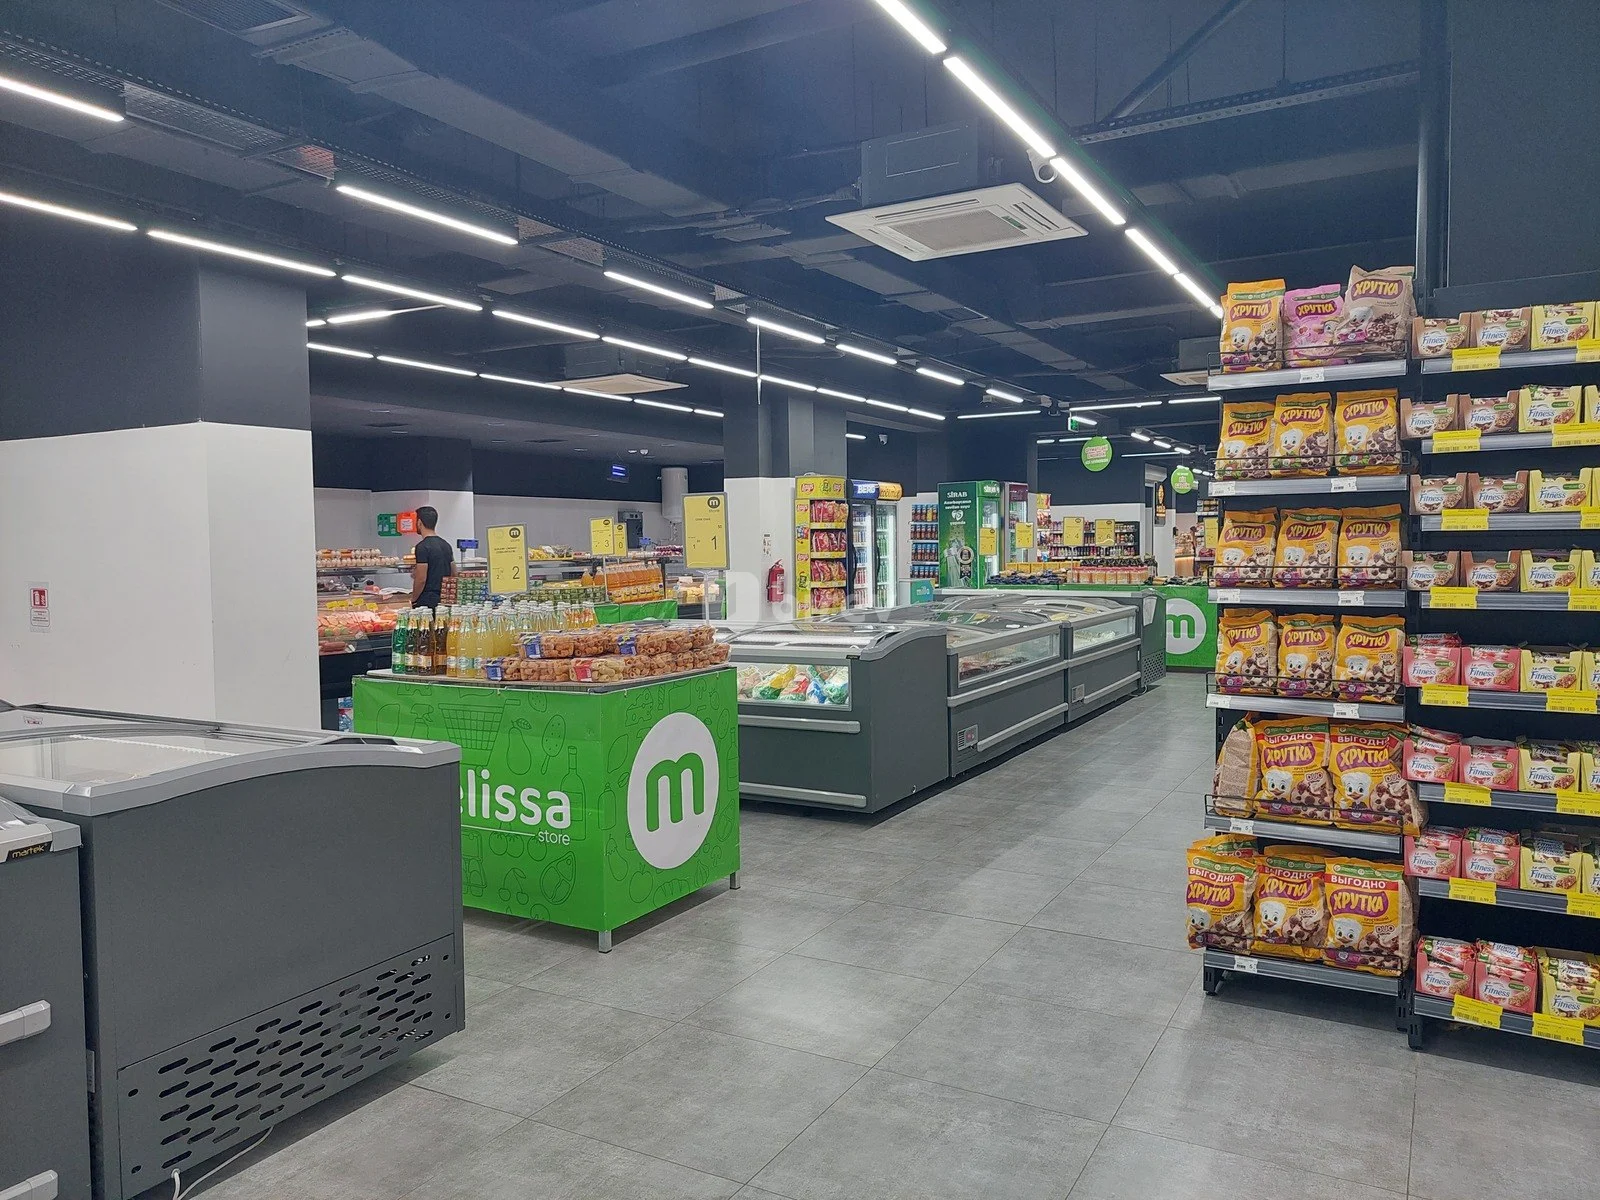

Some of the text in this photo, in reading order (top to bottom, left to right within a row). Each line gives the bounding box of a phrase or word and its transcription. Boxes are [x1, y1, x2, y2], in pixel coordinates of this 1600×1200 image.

[1354, 280, 1399, 296] ХРУТКА
[1232, 303, 1270, 317] ХРУТКА
[1298, 302, 1335, 315] ХРУТКА
[1481, 330, 1507, 340] Fitness
[1542, 325, 1569, 335] Fitness
[1422, 336, 1447, 345] Fitness
[1346, 399, 1385, 416] ХРУТКА
[1528, 408, 1555, 418] Fitness
[1281, 408, 1321, 421] ХРУТКА
[1470, 413, 1495, 422] Fitness
[1410, 417, 1435, 426] Fitness
[1230, 421, 1264, 436] ХРУТКА
[1419, 493, 1443, 503] Fitness
[1479, 492, 1504, 502] Fitness
[1539, 490, 1566, 500] Fitness
[1226, 526, 1263, 539] ХРУТКА
[1289, 524, 1325, 536] ХРУТКА
[1349, 523, 1387, 536] ХРУТКА
[604, 539, 610, 548] 3
[711, 534, 718, 551] 1
[512, 565, 521, 580] 2
[1410, 571, 1434, 581] Fitness
[1471, 570, 1497, 581] Fitness
[1529, 570, 1556, 580] Fitness
[1287, 630, 1324, 642] ХРУТКА
[1349, 634, 1387, 646] ХРУТКА
[1412, 665, 1437, 676] Fitness
[1469, 667, 1495, 678] Fitness
[1530, 671, 1557, 681] Fitness
[1267, 746, 1311, 762] ХРУТКА
[1341, 748, 1389, 766] ХРУТКА
[1411, 760, 1435, 771] Fitness
[1468, 766, 1494, 777] Fitness
[1528, 771, 1555, 781] Fitness
[646, 752, 706, 833] m
[538, 830, 571, 846] store
[1480, 834, 1503, 844] Fitness
[12, 845, 45, 858] martek
[1412, 855, 1437, 866] Fitness
[1470, 862, 1496, 873] Fitness
[1189, 868, 1235, 882] ВЫГОДНО
[1530, 870, 1557, 881] Fitness
[1261, 878, 1308, 897] ХРУТКА
[1331, 875, 1386, 889] ВЫГОДНО
[1187, 883, 1231, 902] ХРУТКА
[1333, 891, 1384, 912] ХРУТКА
[1425, 973, 1451, 986] Fitness
[1483, 984, 1511, 998] Fitness
[1552, 998, 1581, 1011] Fitness
